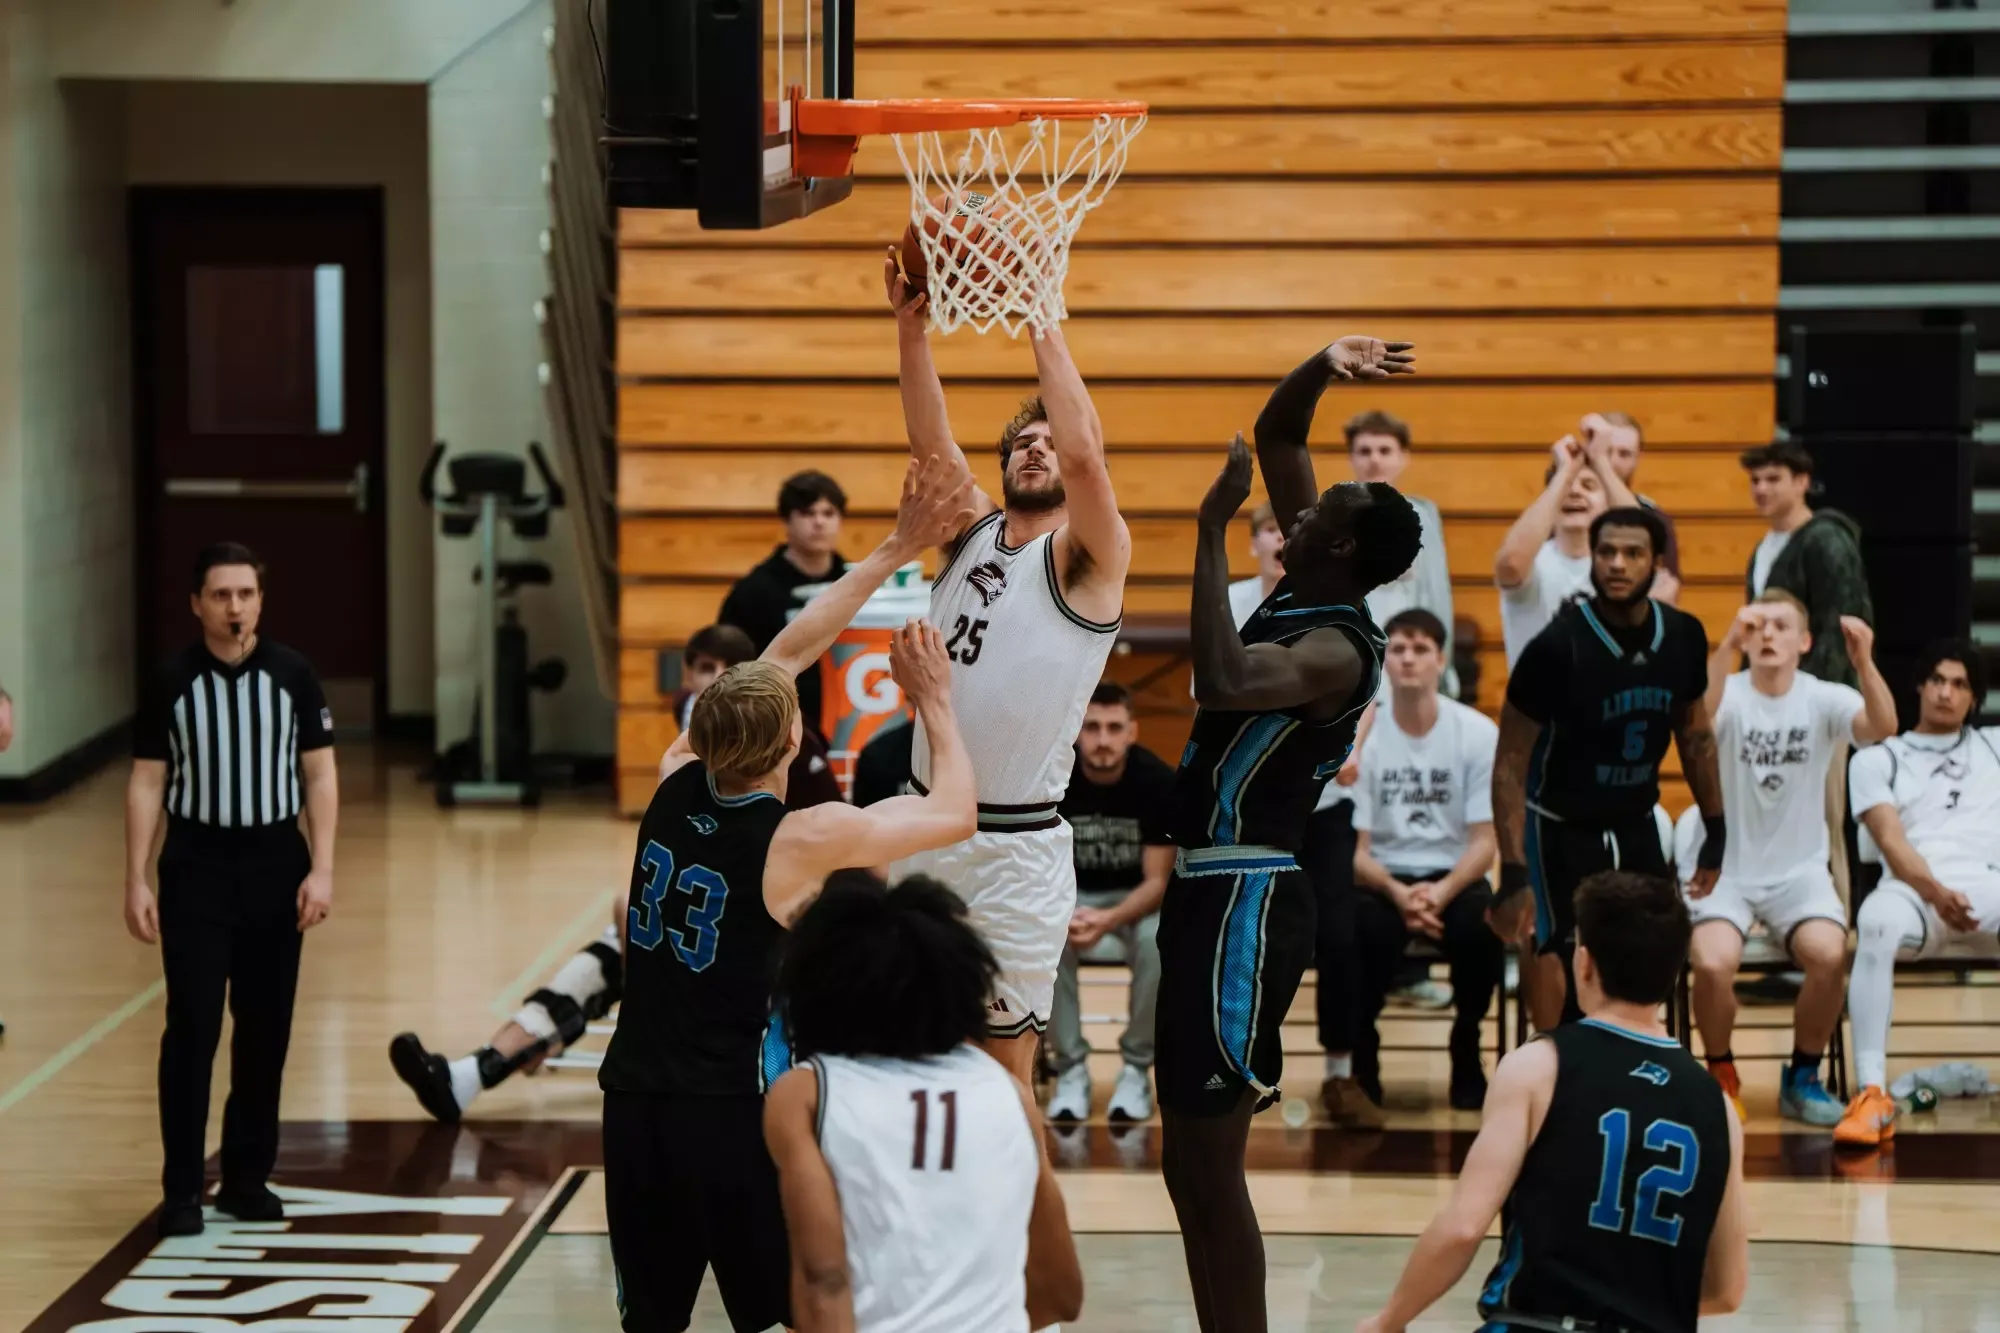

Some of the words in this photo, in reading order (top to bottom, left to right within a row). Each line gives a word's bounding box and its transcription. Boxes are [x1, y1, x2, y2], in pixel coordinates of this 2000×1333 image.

[946, 613, 989, 666] 25
[845, 652, 899, 714] G
[629, 839, 729, 973] 33
[910, 1088, 957, 1171] 11
[1588, 1108, 1700, 1247] 12
